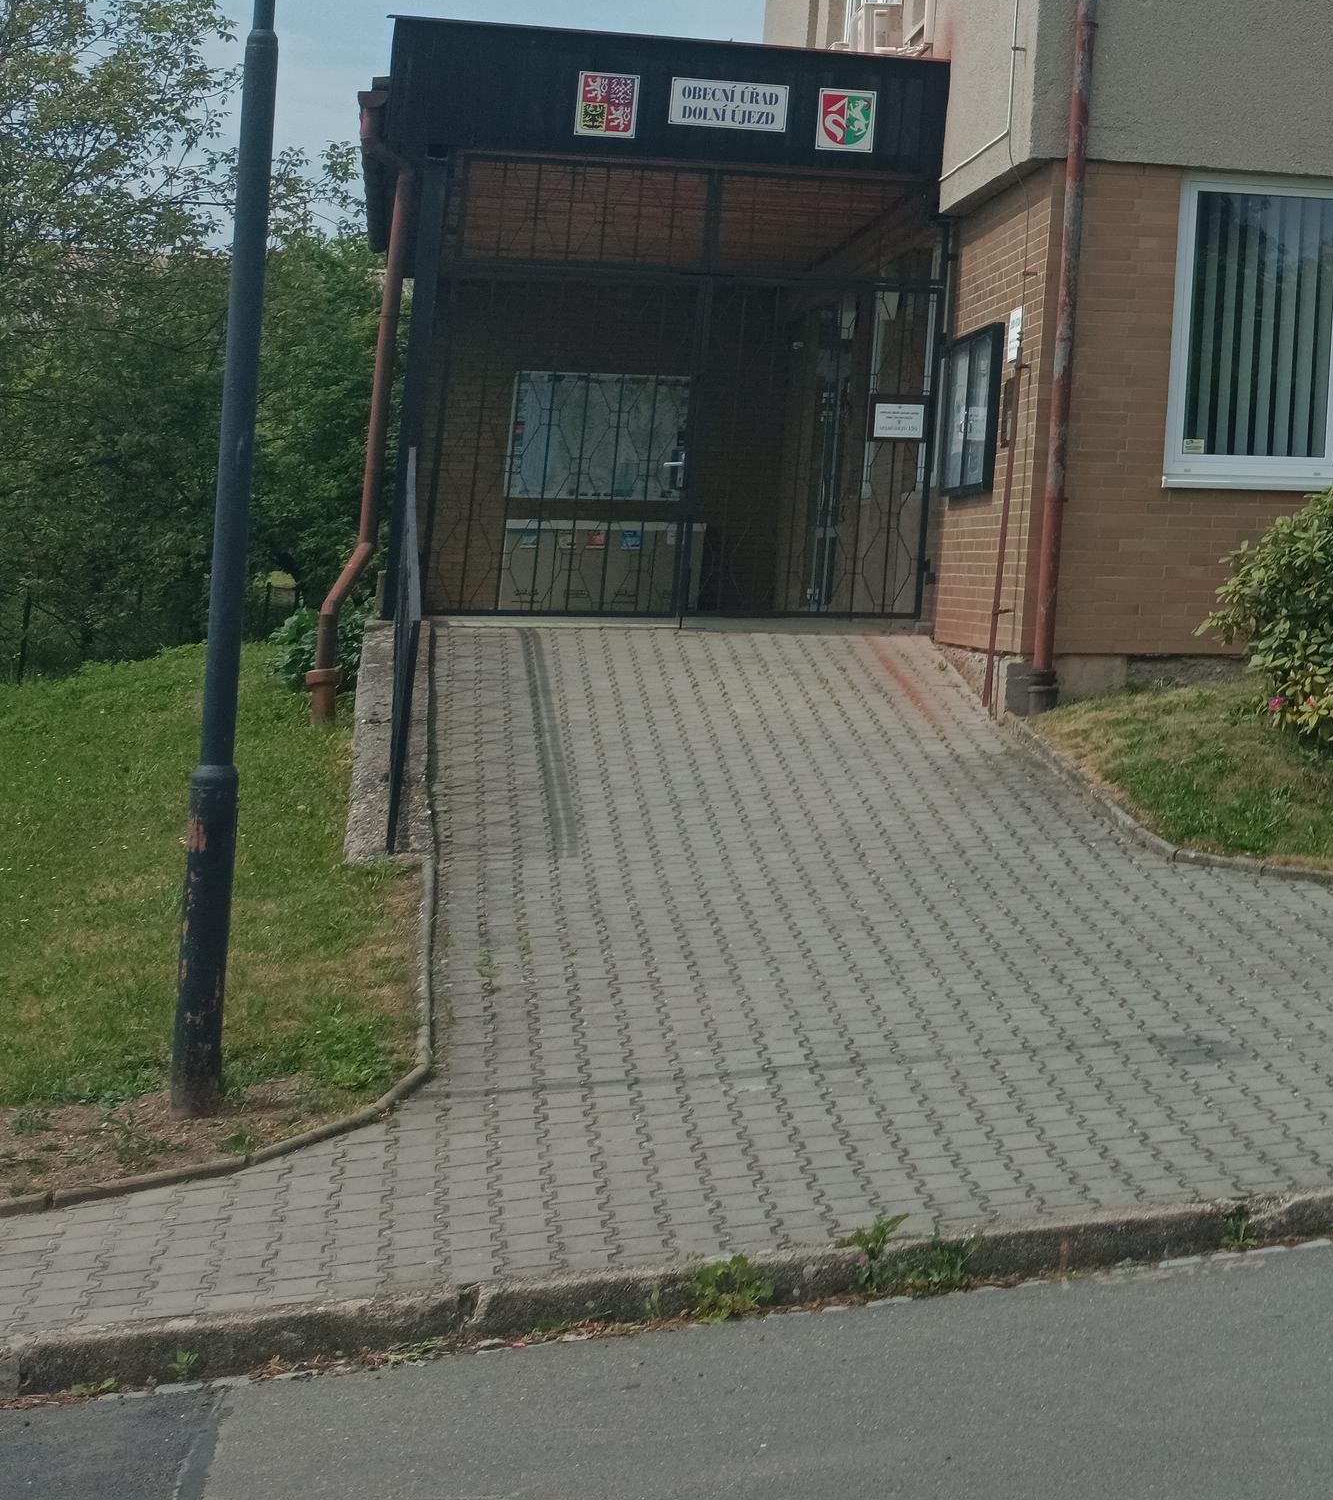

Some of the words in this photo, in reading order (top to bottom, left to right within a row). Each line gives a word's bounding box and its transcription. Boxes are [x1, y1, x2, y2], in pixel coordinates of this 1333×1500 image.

[681, 85, 737, 102] OBECNÍ
[740, 86, 779, 106] ÚŘAD
[681, 104, 728, 121] DOLNÍ
[731, 105, 775, 125] ÚJEZD
